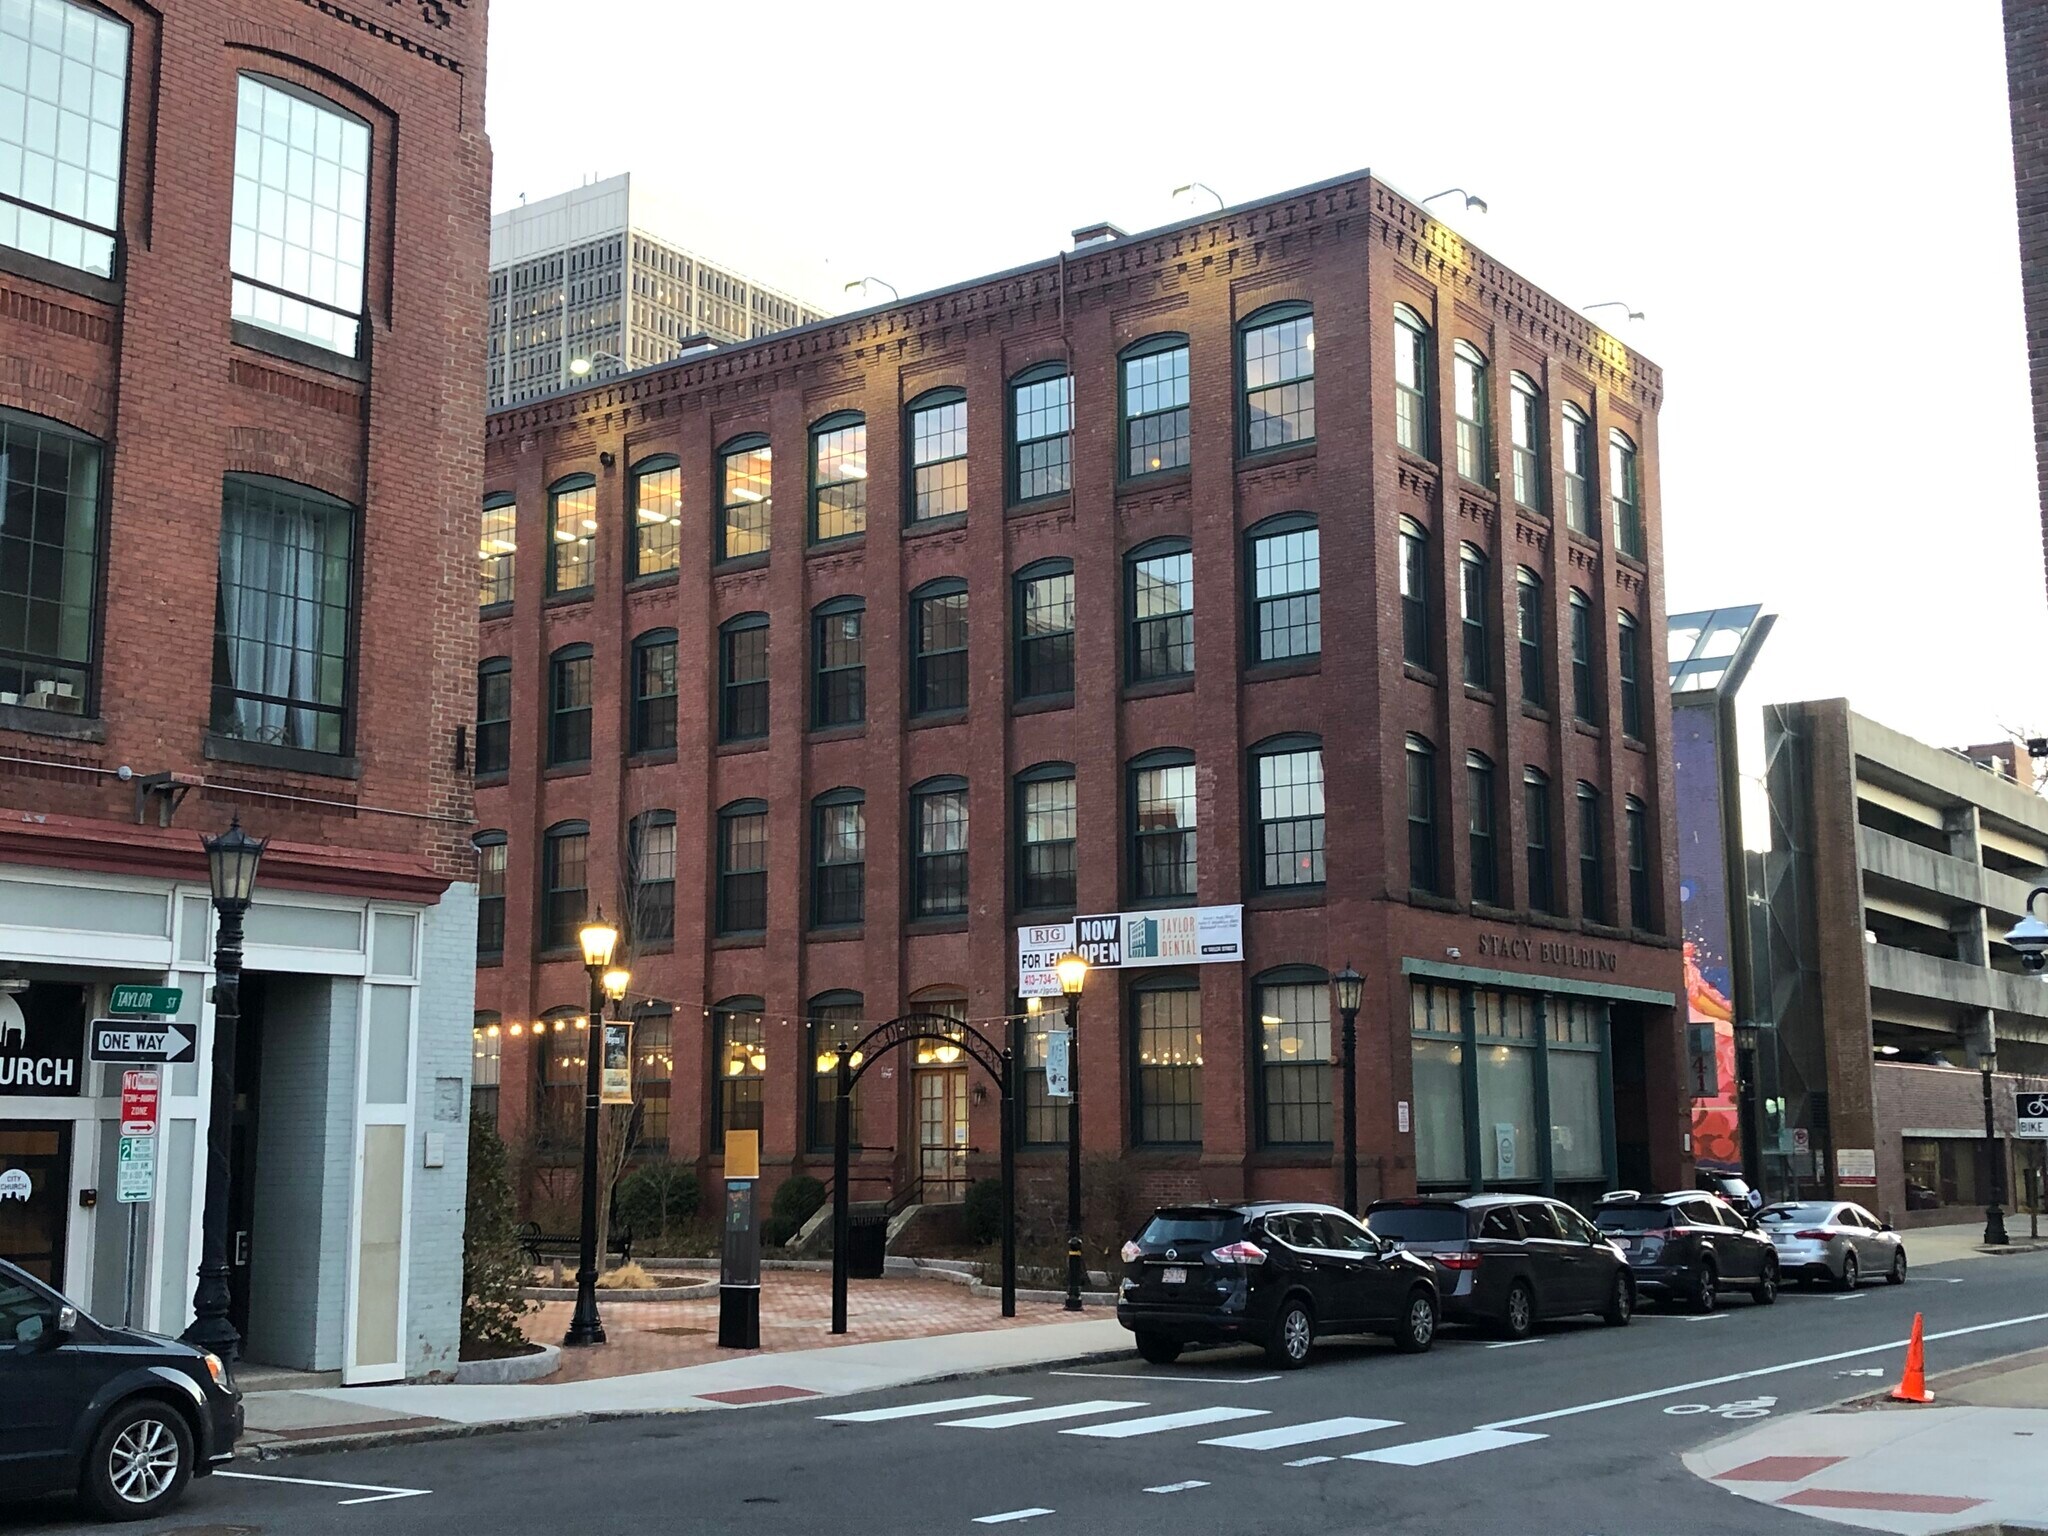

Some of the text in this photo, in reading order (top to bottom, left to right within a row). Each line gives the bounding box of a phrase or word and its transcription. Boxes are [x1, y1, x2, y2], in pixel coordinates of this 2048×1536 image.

[1081, 919, 1117, 941] NOW
[1161, 916, 1195, 934] TAYLOR
[1034, 929, 1061, 944] RJG
[1078, 942, 1120, 964] OPEN
[1162, 940, 1197, 957] DENTAL
[1480, 934, 1617, 971] STACY BUILDING
[1022, 954, 1041, 969] FOR
[117, 991, 177, 1009] TAYLOR ST
[102, 1033, 165, 1050] ONE WAY
[124, 1073, 138, 1090] NO
[130, 1106, 149, 1116] ZONE
[2020, 1121, 2044, 1133] BIKE
[121, 1145, 130, 1160] 2
